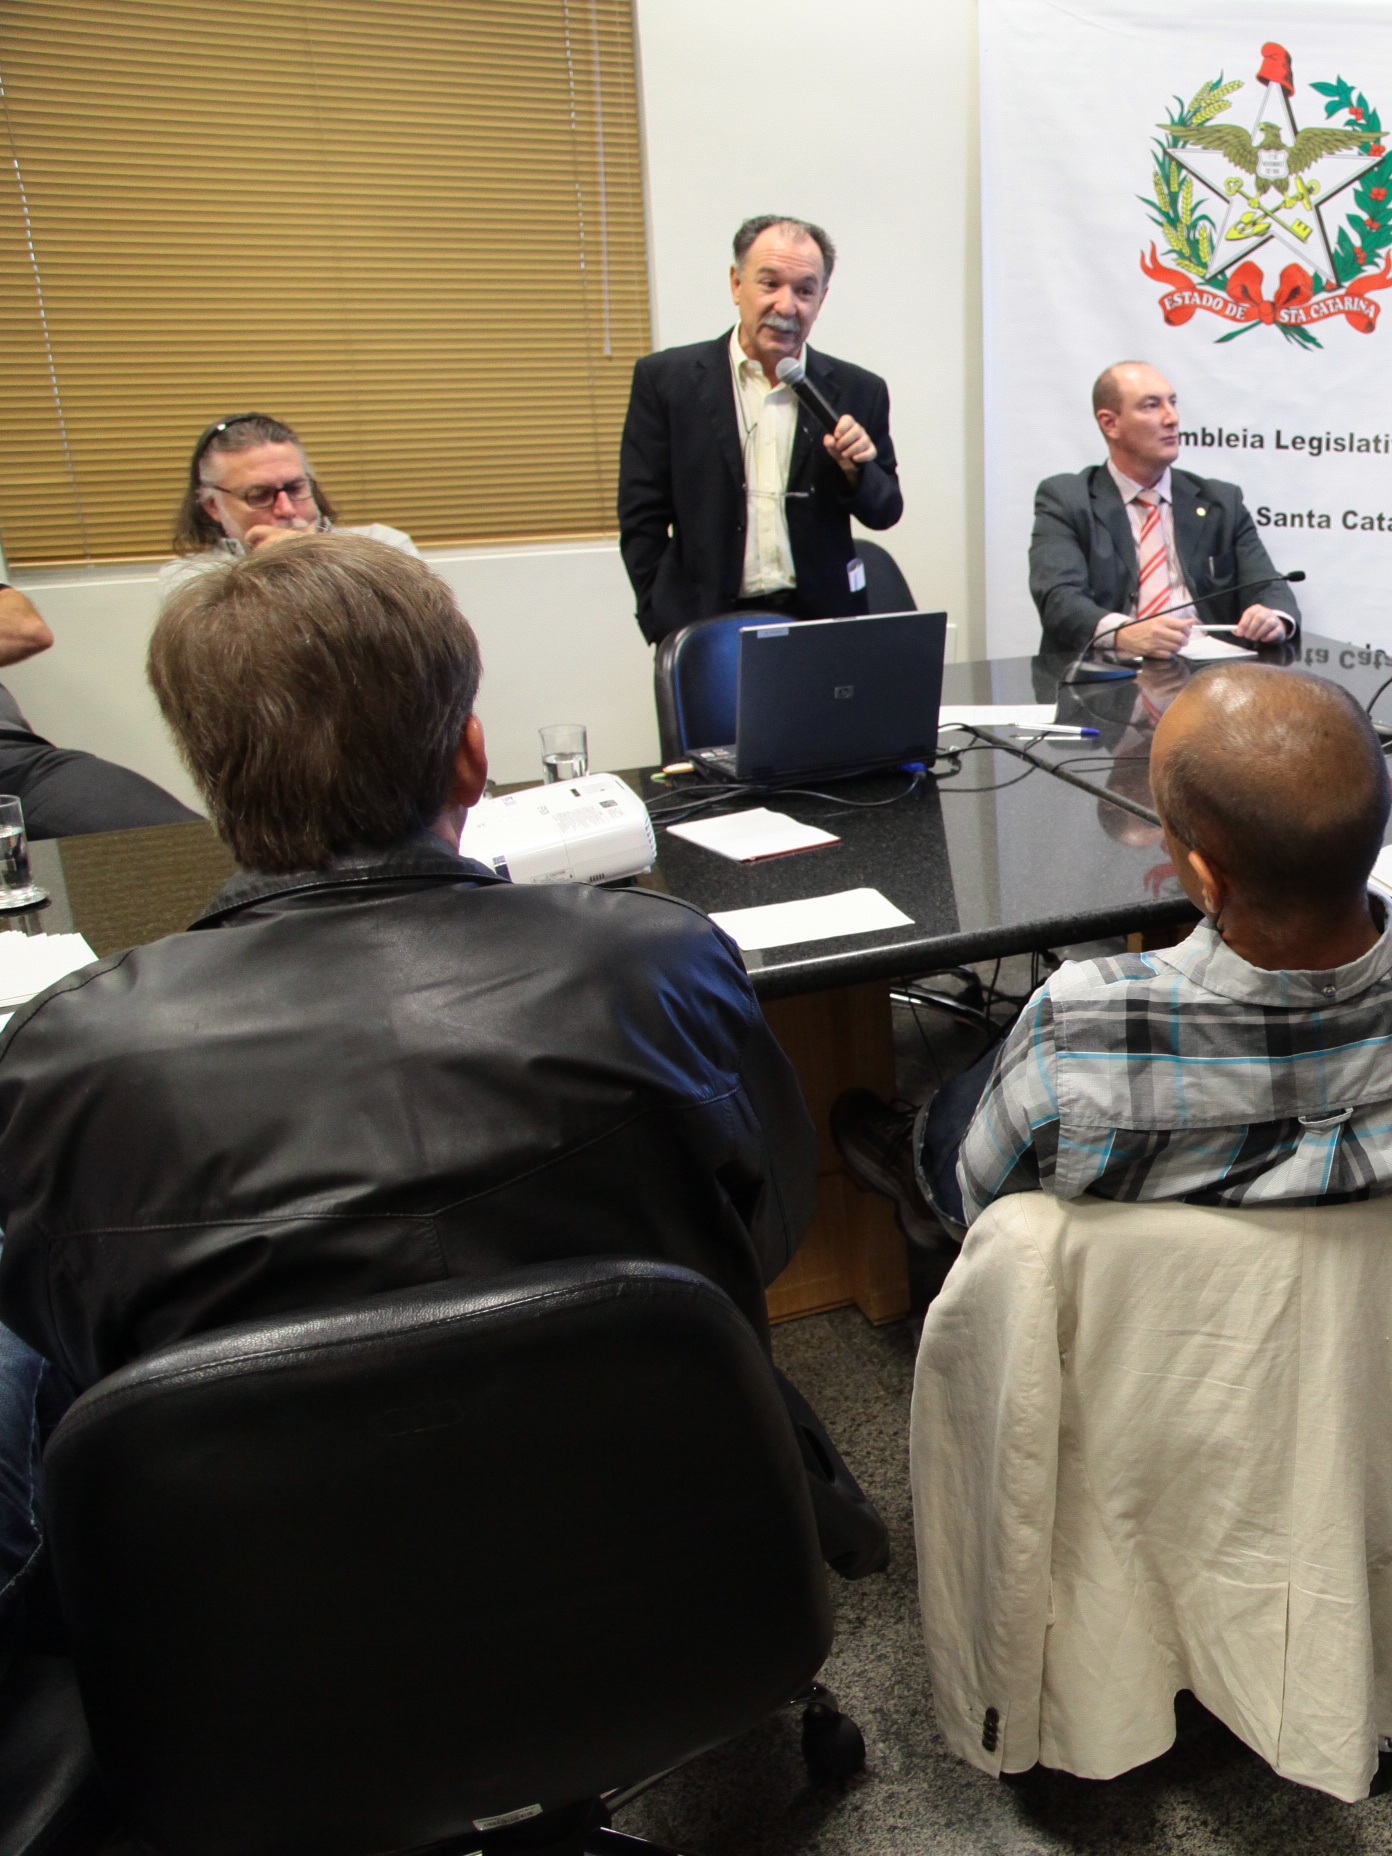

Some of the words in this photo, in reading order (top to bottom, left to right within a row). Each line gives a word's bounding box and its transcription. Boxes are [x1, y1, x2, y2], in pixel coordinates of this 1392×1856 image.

[1163, 290, 1225, 311] ESTADO
[1224, 302, 1248, 321] DE
[1310, 296, 1376, 319] CATARINA
[1178, 427, 1265, 450] mbleia
[1256, 505, 1332, 530] Santa
